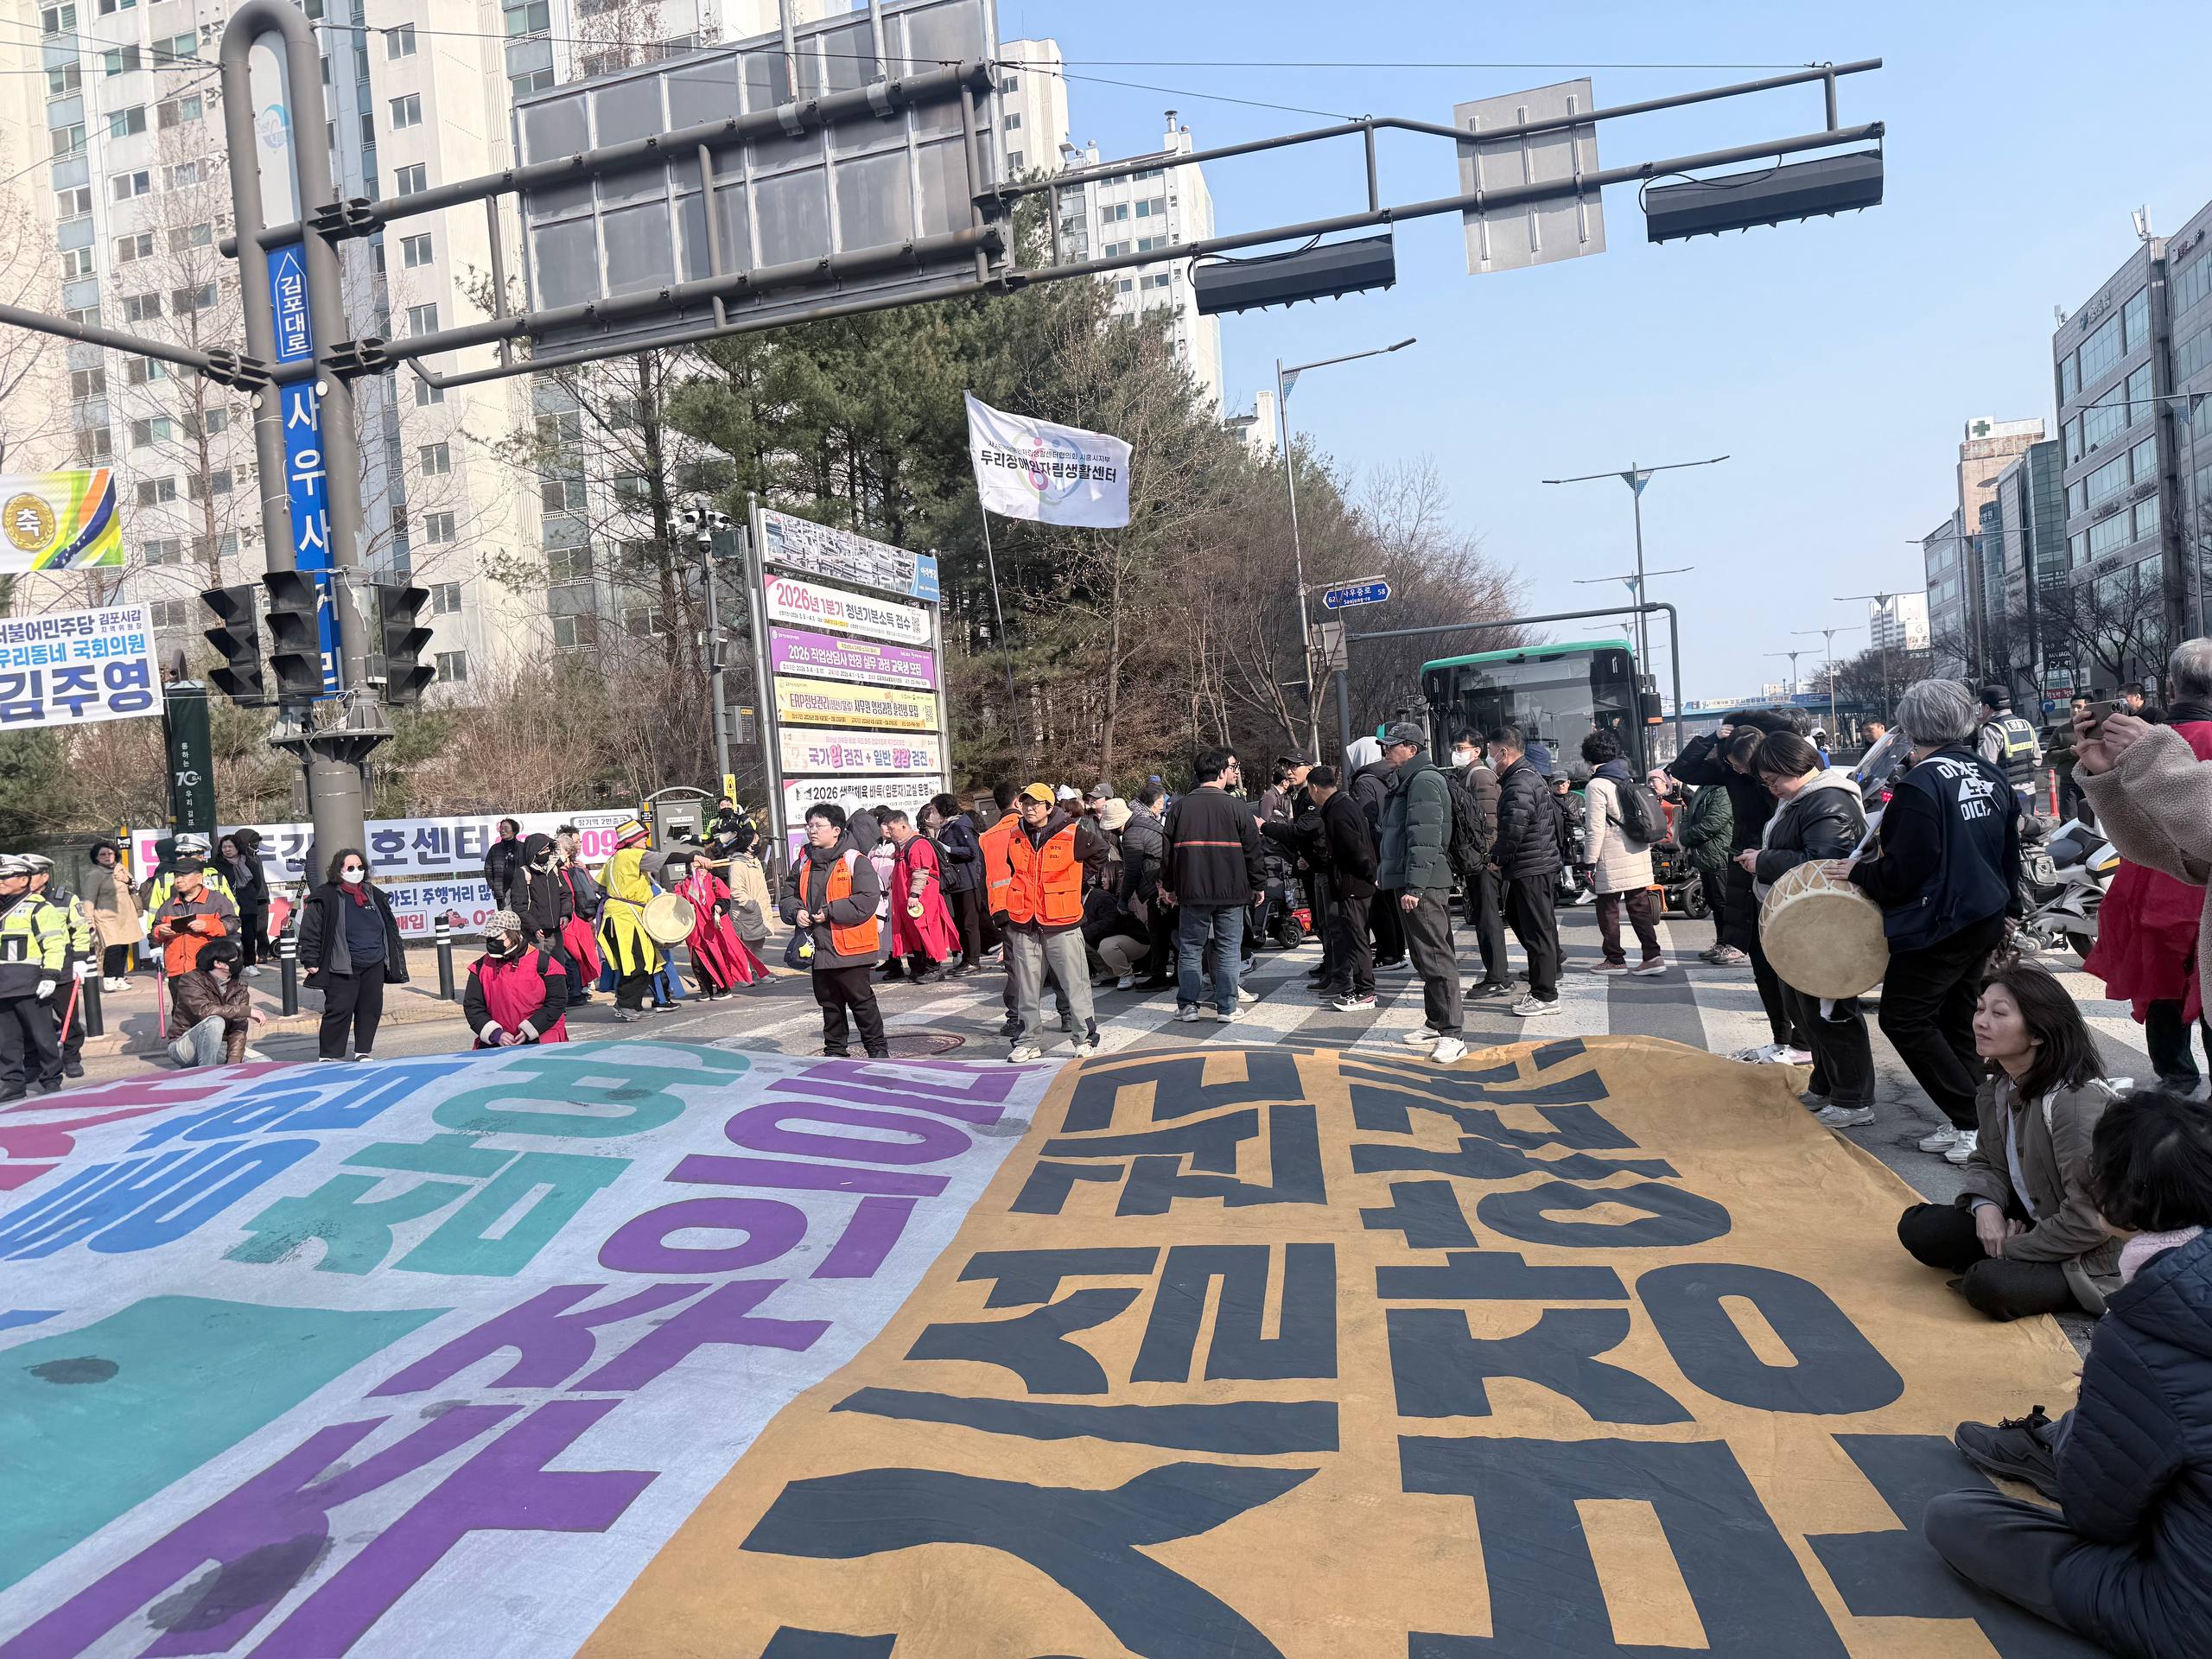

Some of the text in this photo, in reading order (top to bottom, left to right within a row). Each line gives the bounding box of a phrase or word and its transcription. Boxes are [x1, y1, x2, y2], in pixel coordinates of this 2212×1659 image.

[280, 274, 308, 352] 김포대로
[981, 449, 1117, 483] 두리장애인자립생활센터
[15, 508, 42, 537] 축
[776, 582, 820, 613] 2026년
[821, 598, 844, 617] 1분기
[846, 603, 894, 627] 청년기본소득
[99, 609, 142, 626] 김포시갑
[101, 622, 143, 633] 지역위원장
[73, 633, 147, 660] 국회의원
[787, 645, 810, 661] 2026
[0, 658, 154, 723] 김주영
[843, 748, 864, 766] 검진
[874, 749, 892, 766] 일반
[912, 750, 928, 766] 검진
[813, 786, 838, 799] 2026
[423, 885, 474, 906] 주행거리
